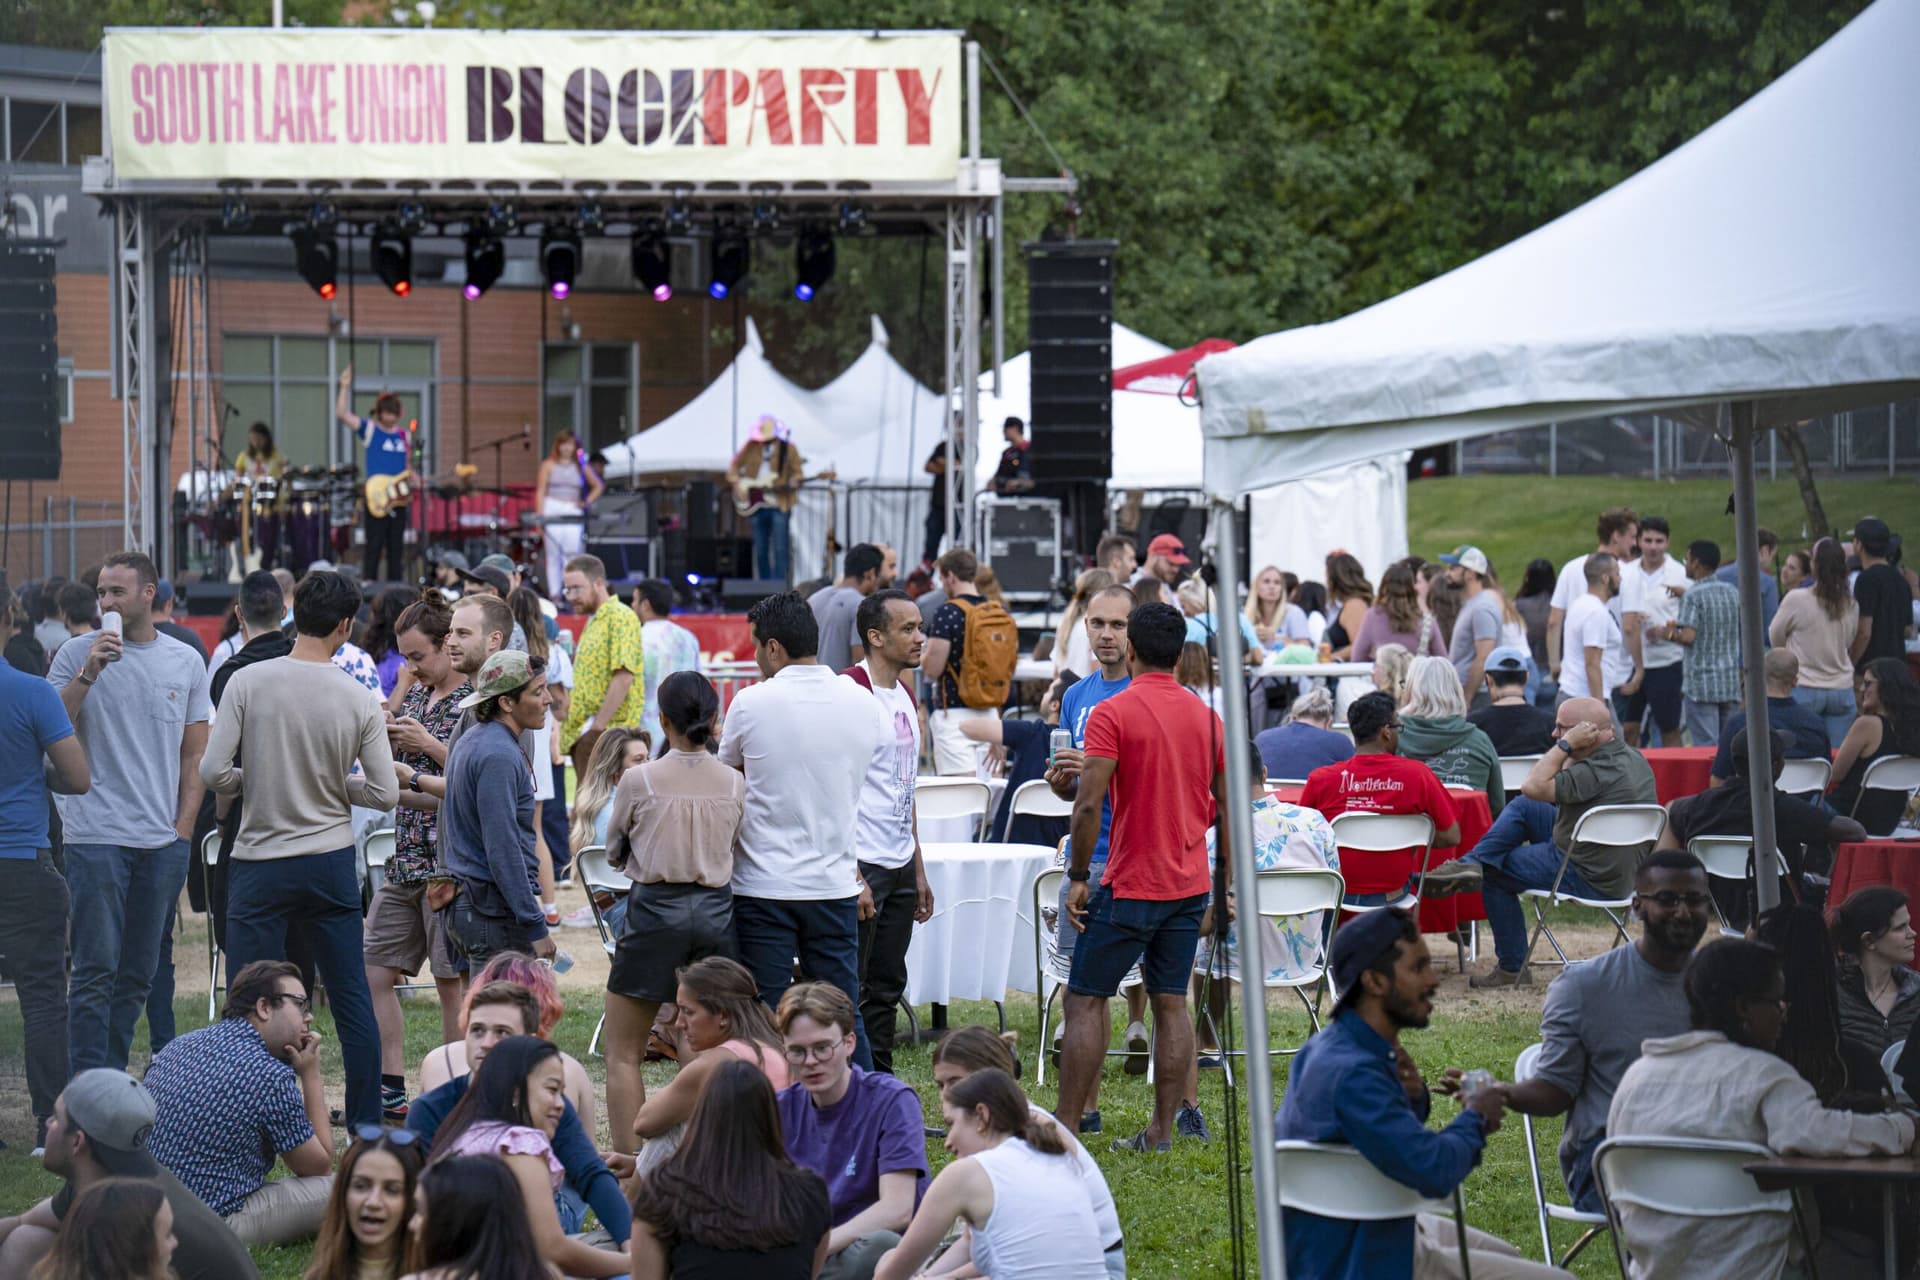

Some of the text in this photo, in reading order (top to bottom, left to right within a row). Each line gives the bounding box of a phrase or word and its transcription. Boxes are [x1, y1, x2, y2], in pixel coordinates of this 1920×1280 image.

[131, 62, 245, 145] SOUTH
[252, 63, 337, 144] LAKE
[345, 63, 448, 144] UNION
